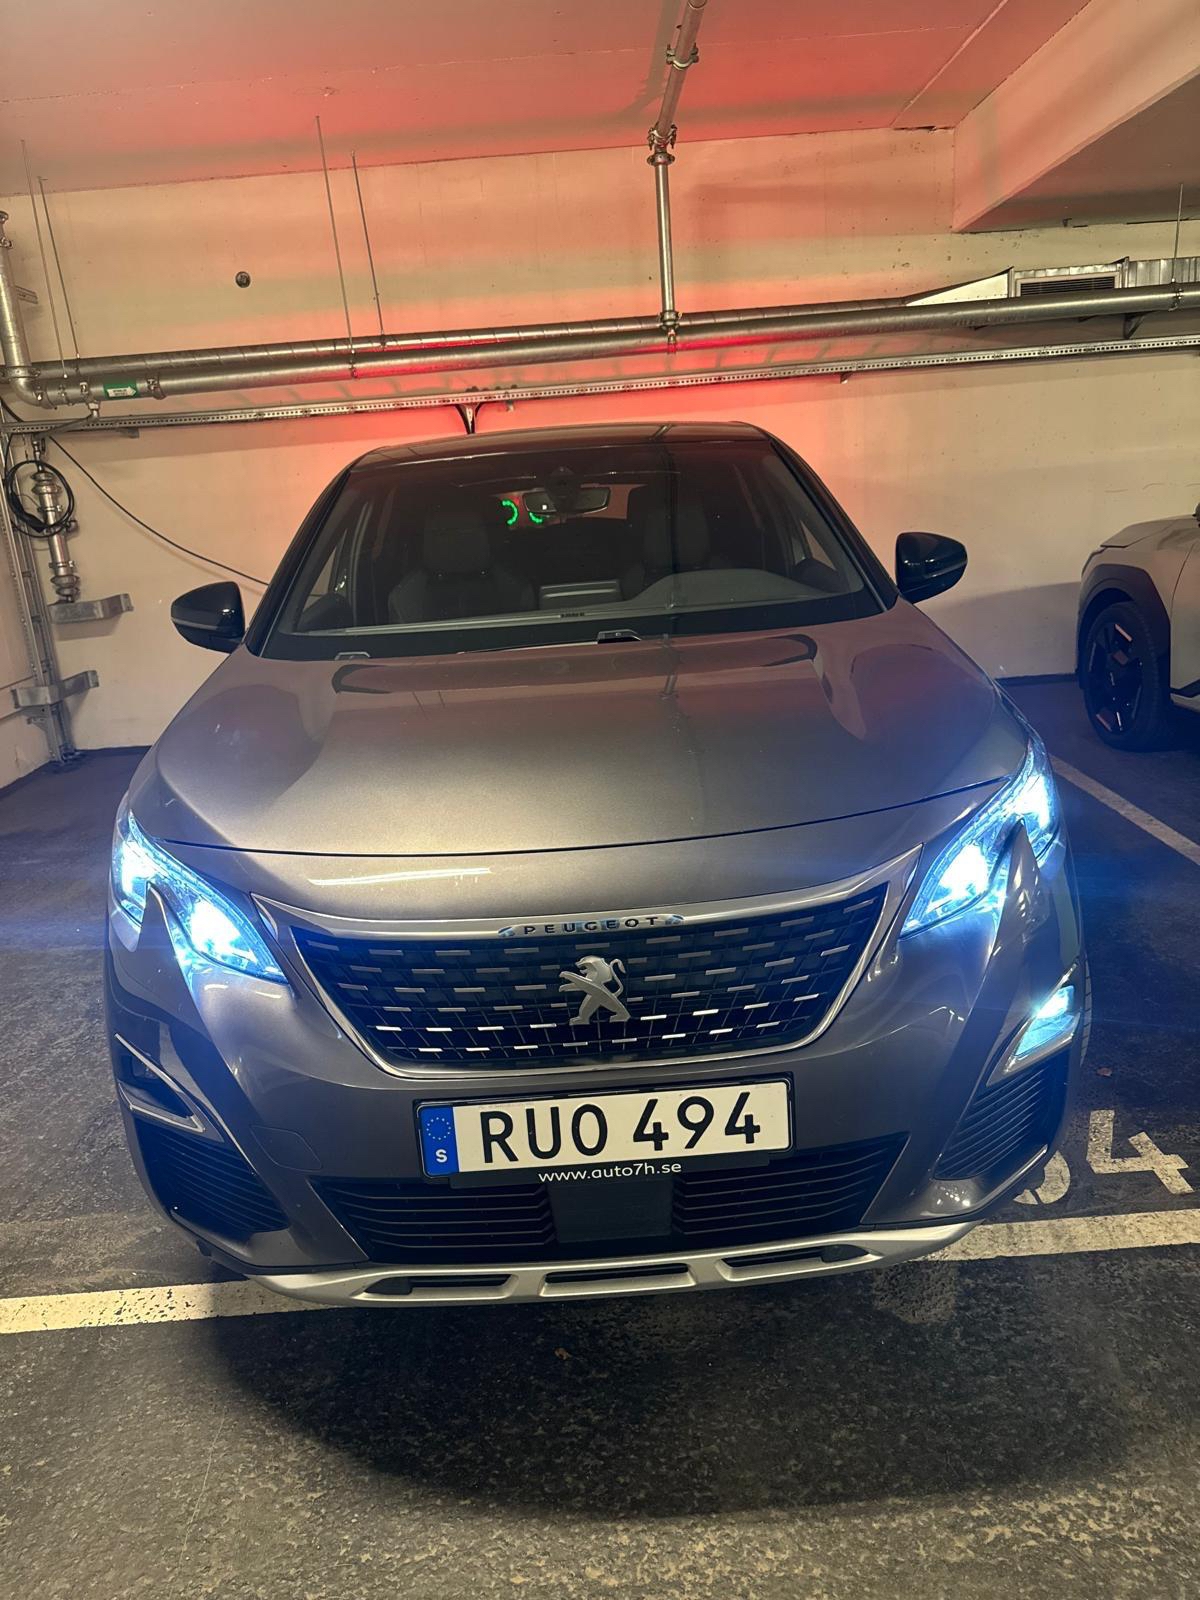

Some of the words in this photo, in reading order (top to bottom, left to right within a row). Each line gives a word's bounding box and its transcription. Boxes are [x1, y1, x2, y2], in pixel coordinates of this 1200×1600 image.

[523, 916, 658, 935] PEUGEOT
[479, 1103, 608, 1164] RUO
[633, 1091, 761, 1152] 494
[435, 1149, 448, 1163] S
[538, 1162, 682, 1183] www.auto7h.se
